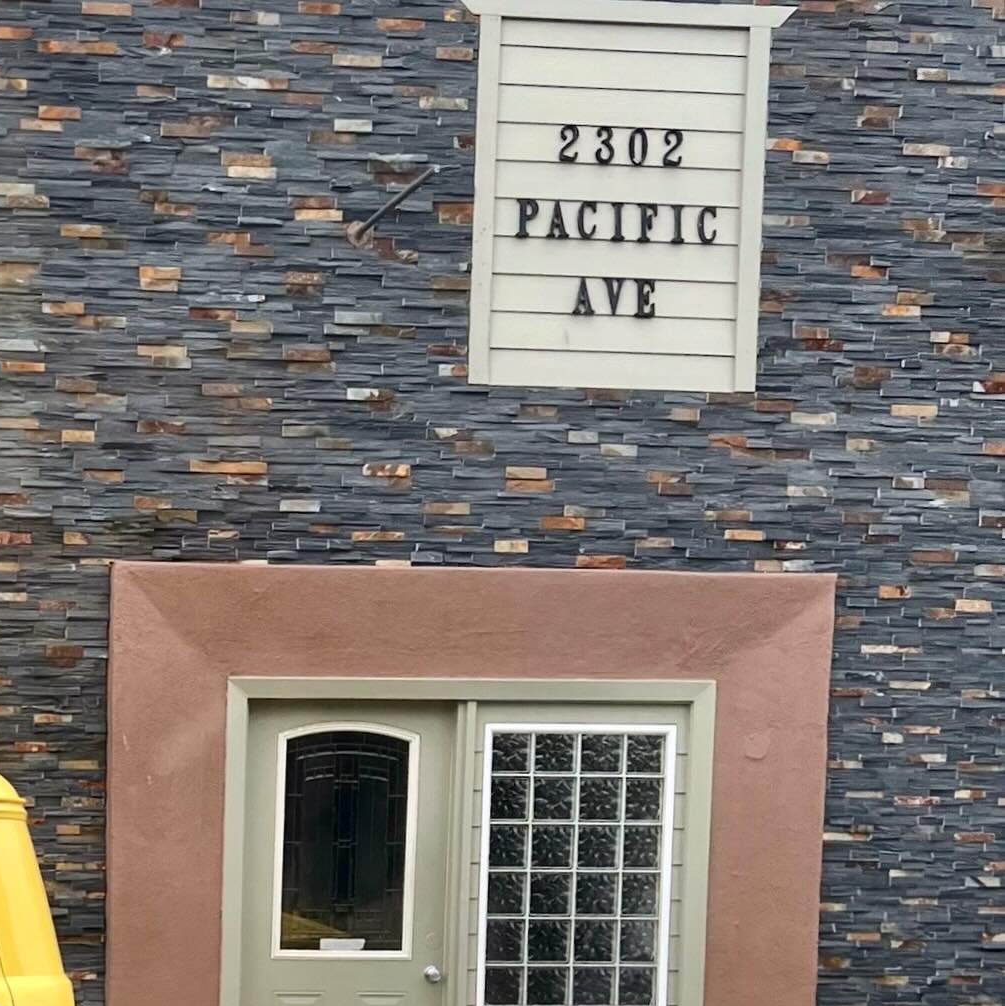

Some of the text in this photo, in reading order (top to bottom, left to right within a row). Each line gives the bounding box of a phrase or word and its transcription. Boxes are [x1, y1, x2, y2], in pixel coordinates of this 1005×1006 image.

[558, 124, 684, 167] 2302
[515, 198, 717, 244] PACIFIC
[572, 276, 656, 319] AVE
